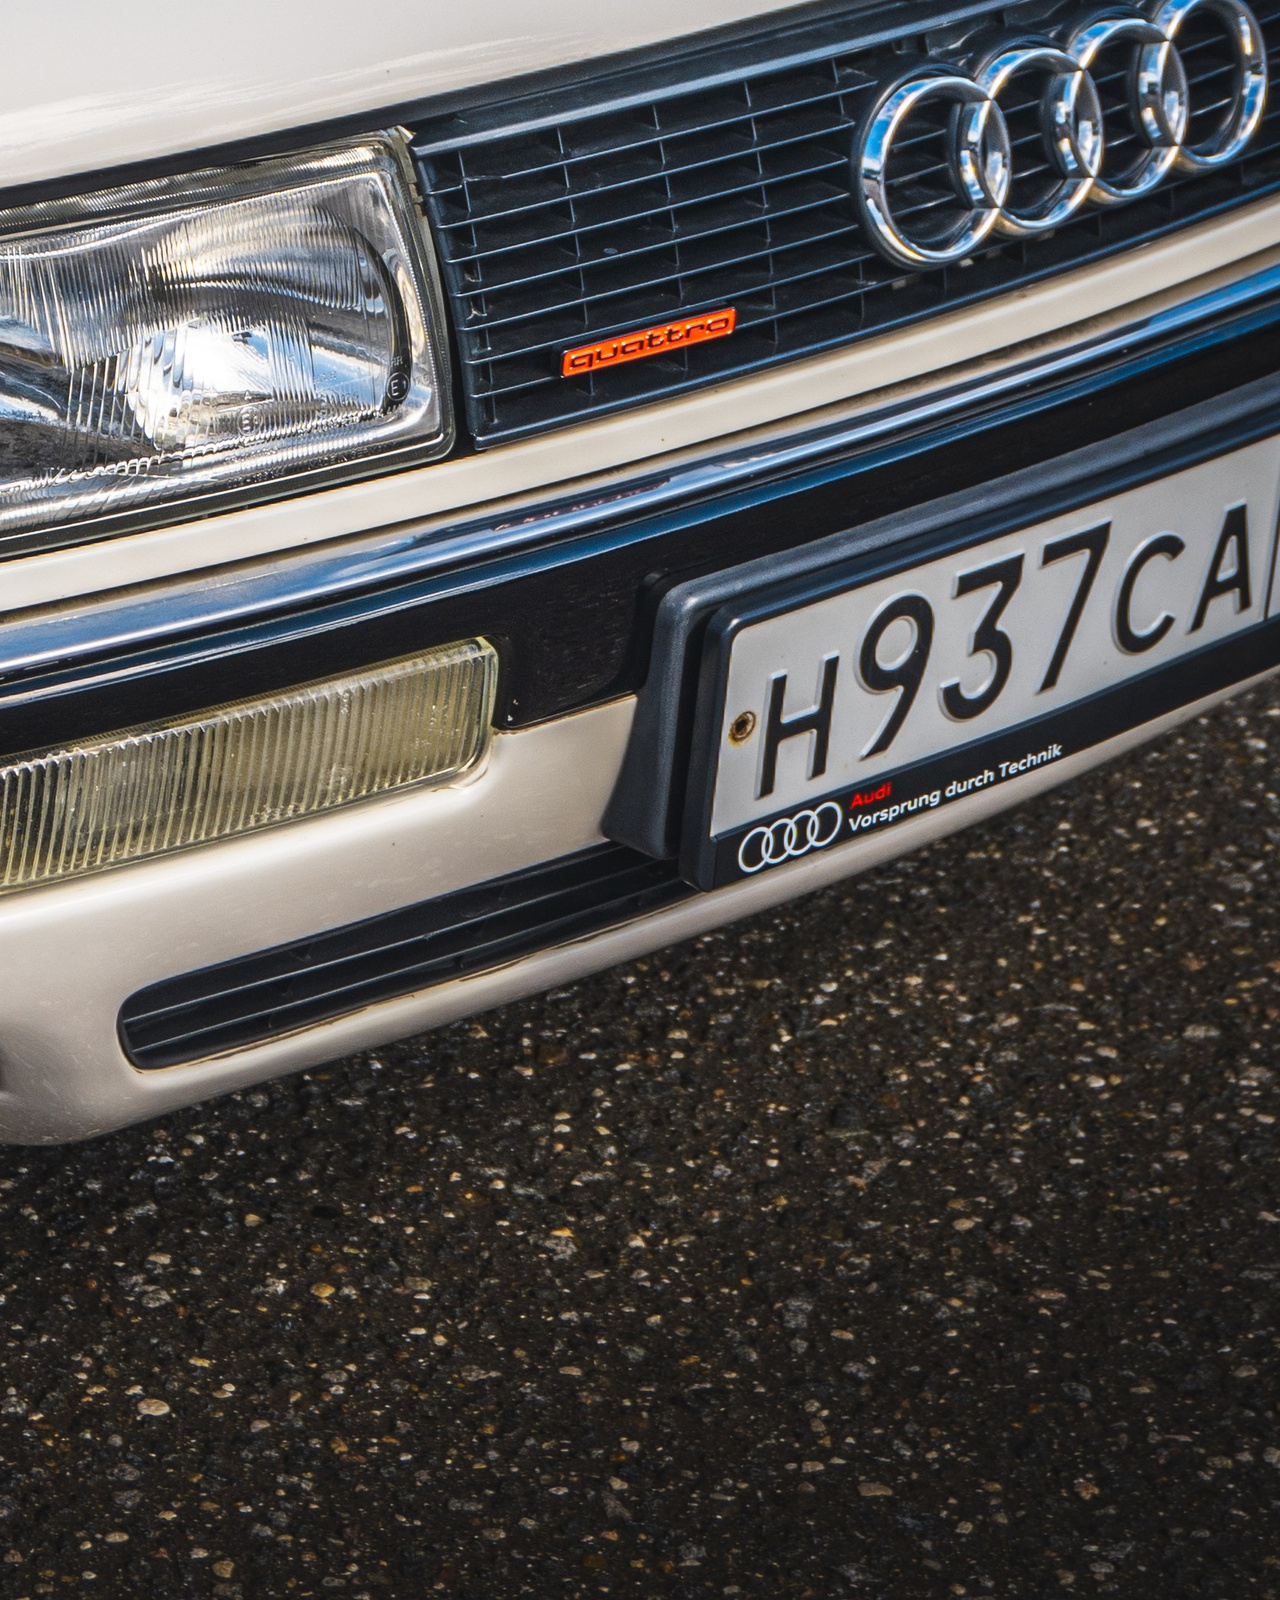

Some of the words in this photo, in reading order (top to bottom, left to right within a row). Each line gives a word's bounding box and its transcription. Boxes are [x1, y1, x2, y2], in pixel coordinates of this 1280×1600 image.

[570, 316, 730, 368] quattro
[848, 789, 941, 831] Vorsprung
[945, 769, 995, 798] durch
[998, 743, 1063, 778] Technik
[849, 782, 892, 809] Audi
